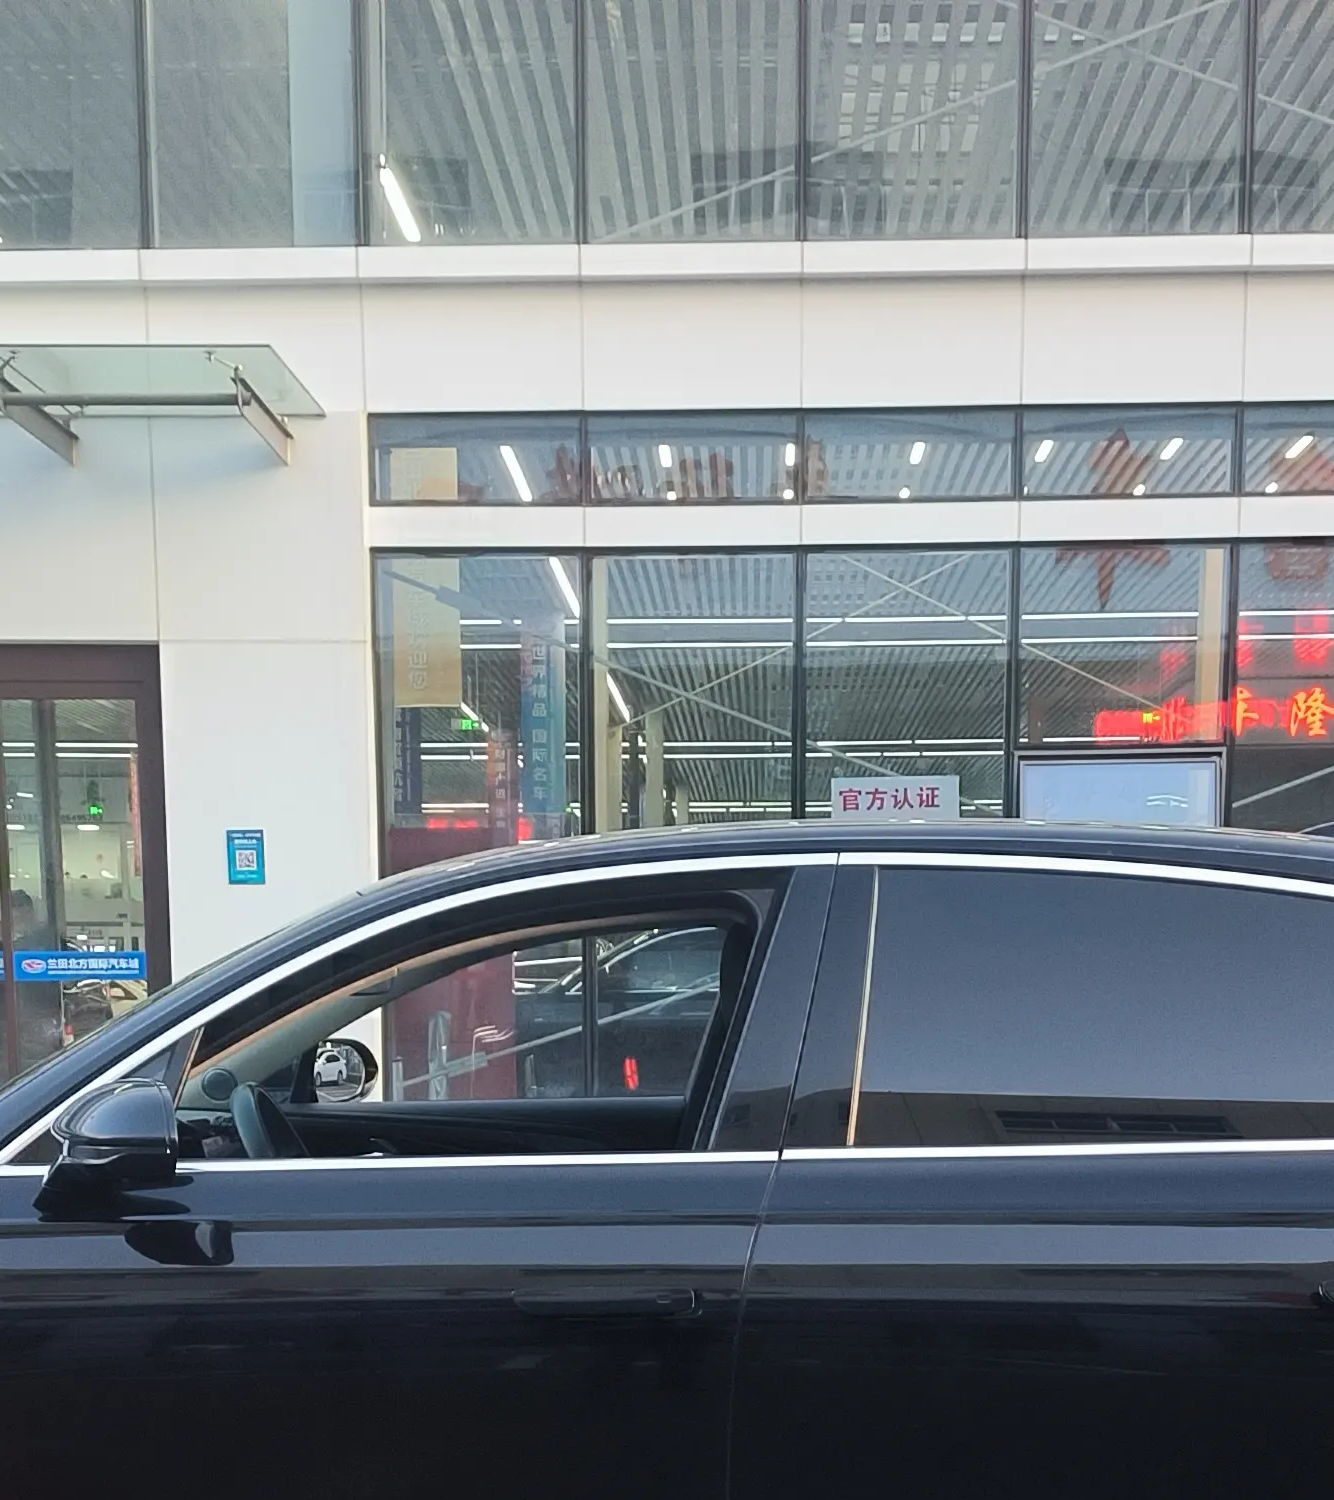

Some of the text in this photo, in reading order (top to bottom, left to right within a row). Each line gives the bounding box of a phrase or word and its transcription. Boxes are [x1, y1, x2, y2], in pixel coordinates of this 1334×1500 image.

[532, 729, 548, 801] 国际名车
[838, 786, 940, 811] 官方认证
